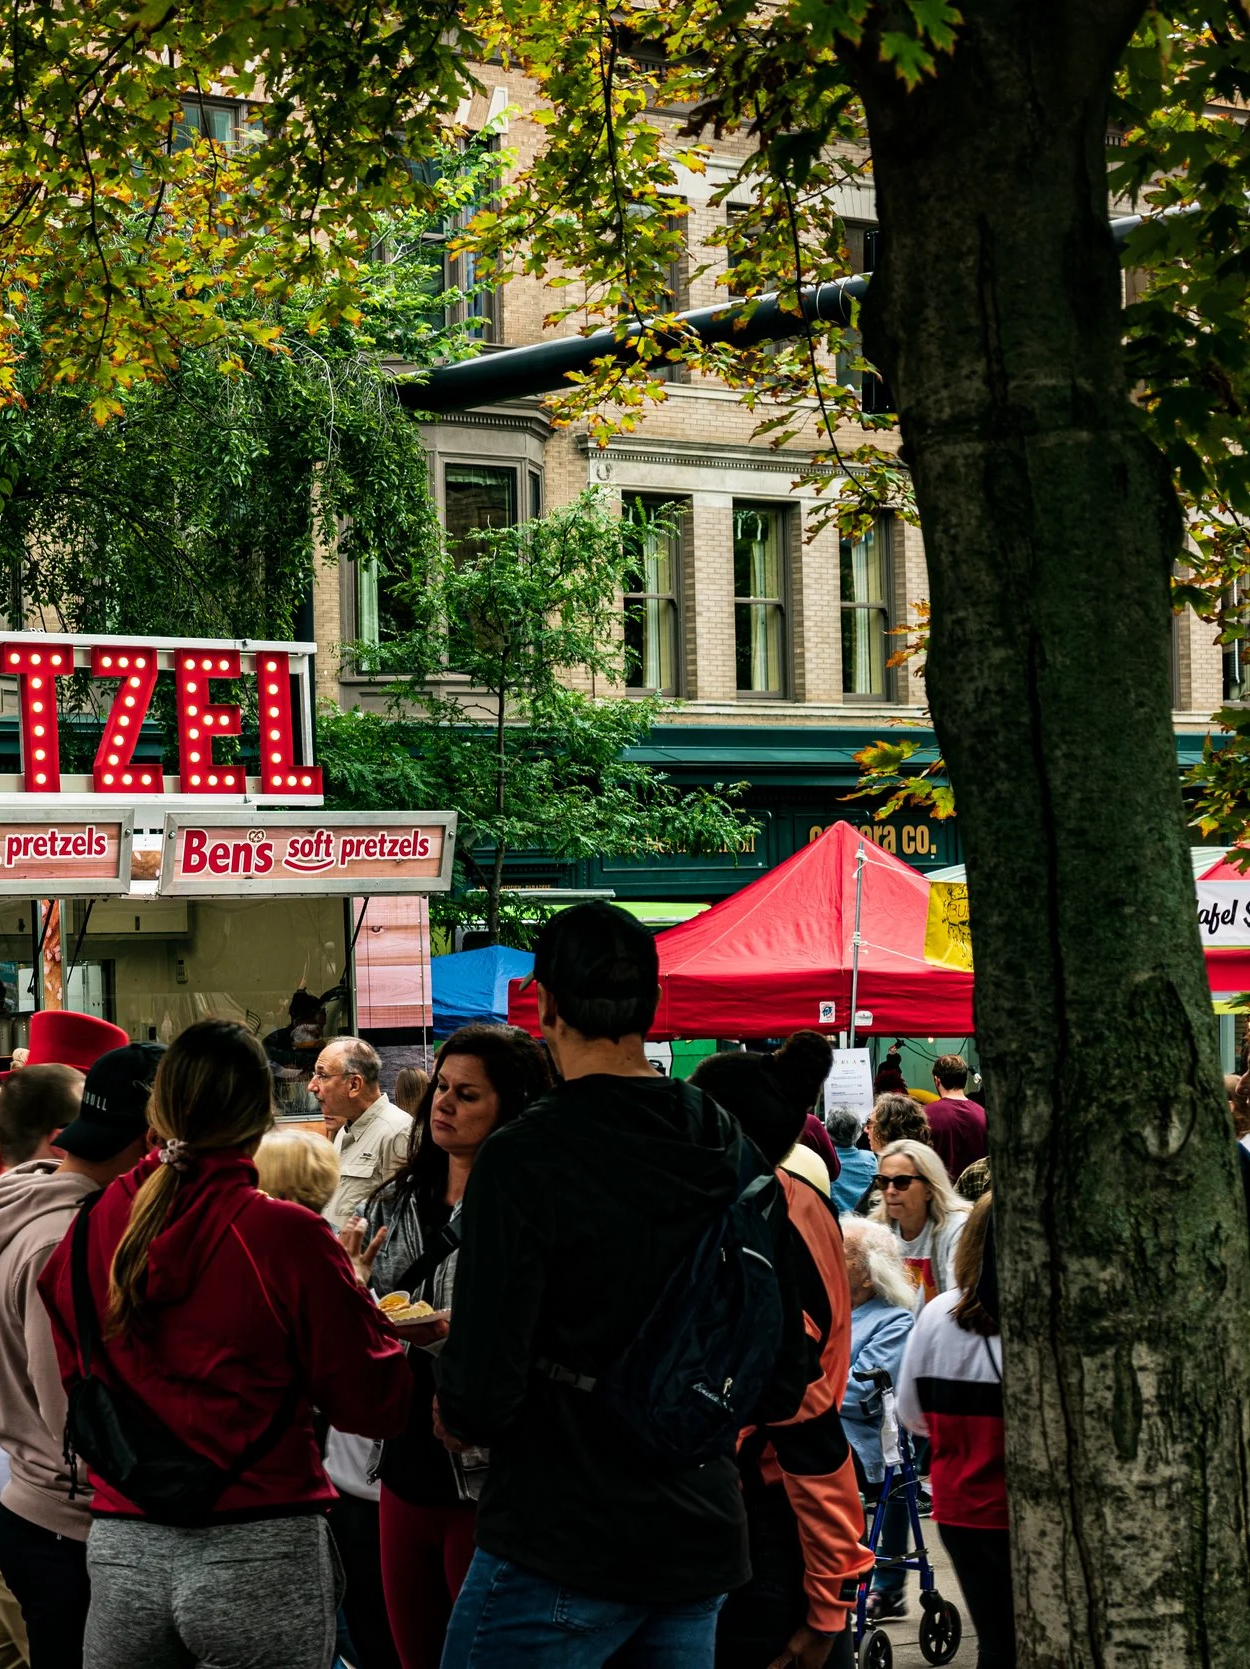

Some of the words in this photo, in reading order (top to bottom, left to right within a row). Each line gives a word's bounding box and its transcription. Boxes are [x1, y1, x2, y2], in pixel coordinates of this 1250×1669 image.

[5, 827, 106, 866] pretzels
[288, 831, 333, 858] soft
[340, 829, 430, 867] pretzels
[901, 825, 937, 855] co.
[1194, 899, 1239, 935] afel
